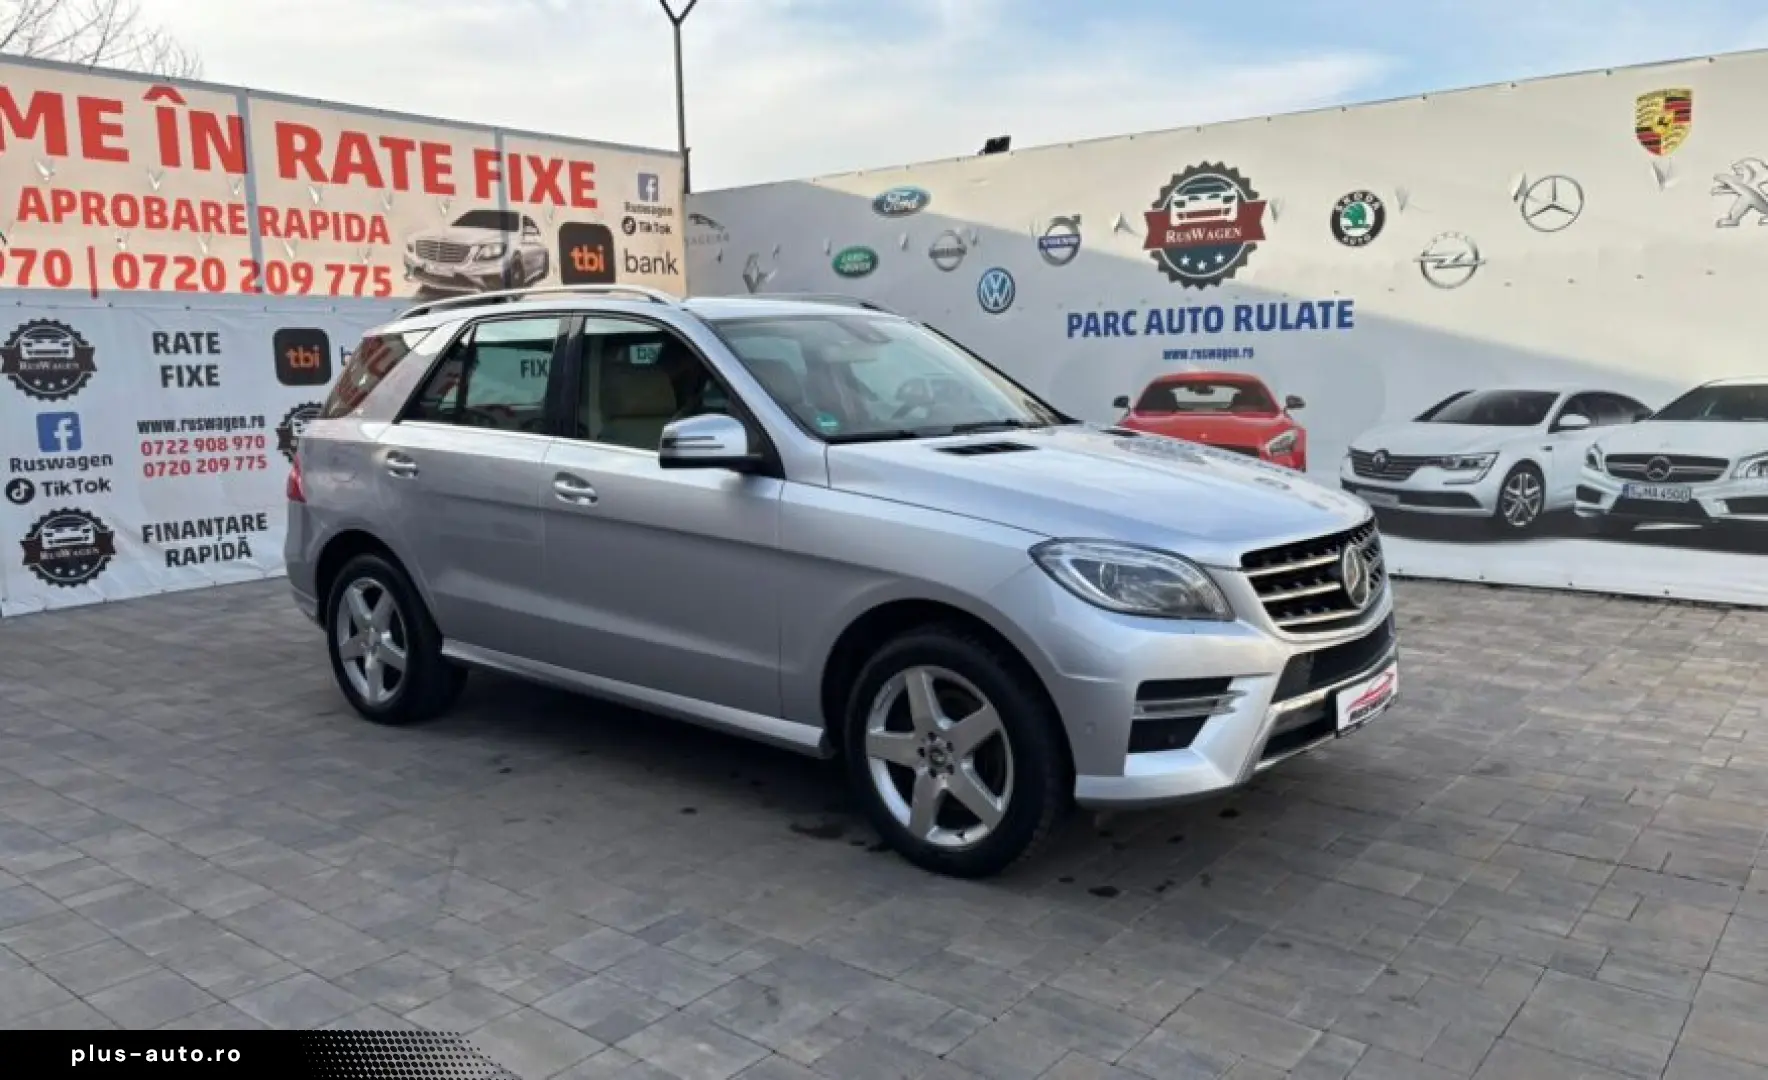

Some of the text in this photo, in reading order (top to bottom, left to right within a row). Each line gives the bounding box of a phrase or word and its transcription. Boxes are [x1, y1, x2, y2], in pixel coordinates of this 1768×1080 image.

[143, 84, 248, 174] ÎN
[274, 121, 455, 196] RATE
[473, 147, 598, 209] FIXE
[17, 187, 391, 245] APROBARE RAPIDA
[570, 245, 679, 275] tbi bank
[0, 247, 73, 287] 70
[112, 252, 227, 293] 0720
[240, 260, 315, 295] 209
[325, 264, 393, 298] 775
[1067, 300, 1354, 338] PARC AUTO RULATE
[152, 331, 221, 355] RATE
[286, 345, 320, 368] tbi
[160, 364, 220, 388] FIXE
[137, 416, 265, 434] www.ruswagen.ro
[141, 435, 265, 456] 0722 908 970
[10, 453, 113, 473] Ruswagen
[143, 455, 267, 478] 0720 209 775
[41, 478, 112, 497] TikTok
[142, 512, 267, 544] FINANȚARE
[165, 536, 252, 567] RAPIDĂ
